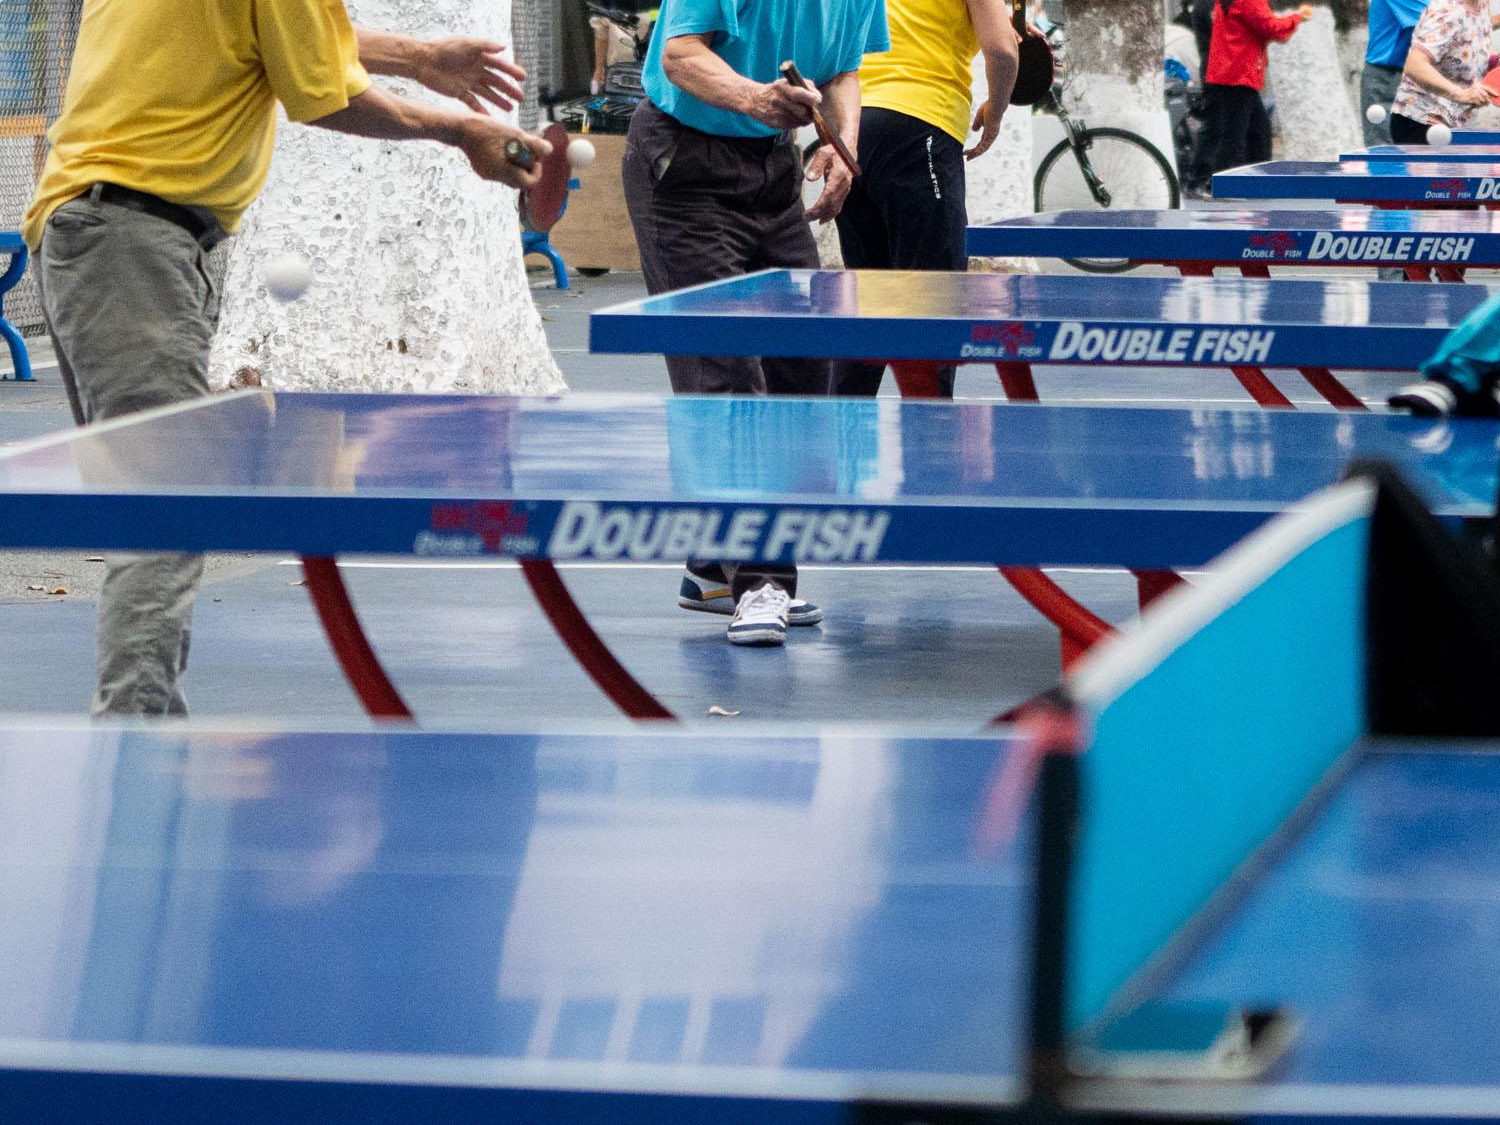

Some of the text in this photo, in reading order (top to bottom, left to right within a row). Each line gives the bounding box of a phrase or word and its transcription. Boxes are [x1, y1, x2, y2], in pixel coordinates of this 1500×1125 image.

[1425, 190, 1450, 199] DOUBLE
[1242, 248, 1302, 259] DOUBLE FISH
[1307, 232, 1475, 261] DOUBLE FISH
[1049, 321, 1276, 363] DOUBLE FISH
[547, 500, 893, 562] DOUBLE FISH
